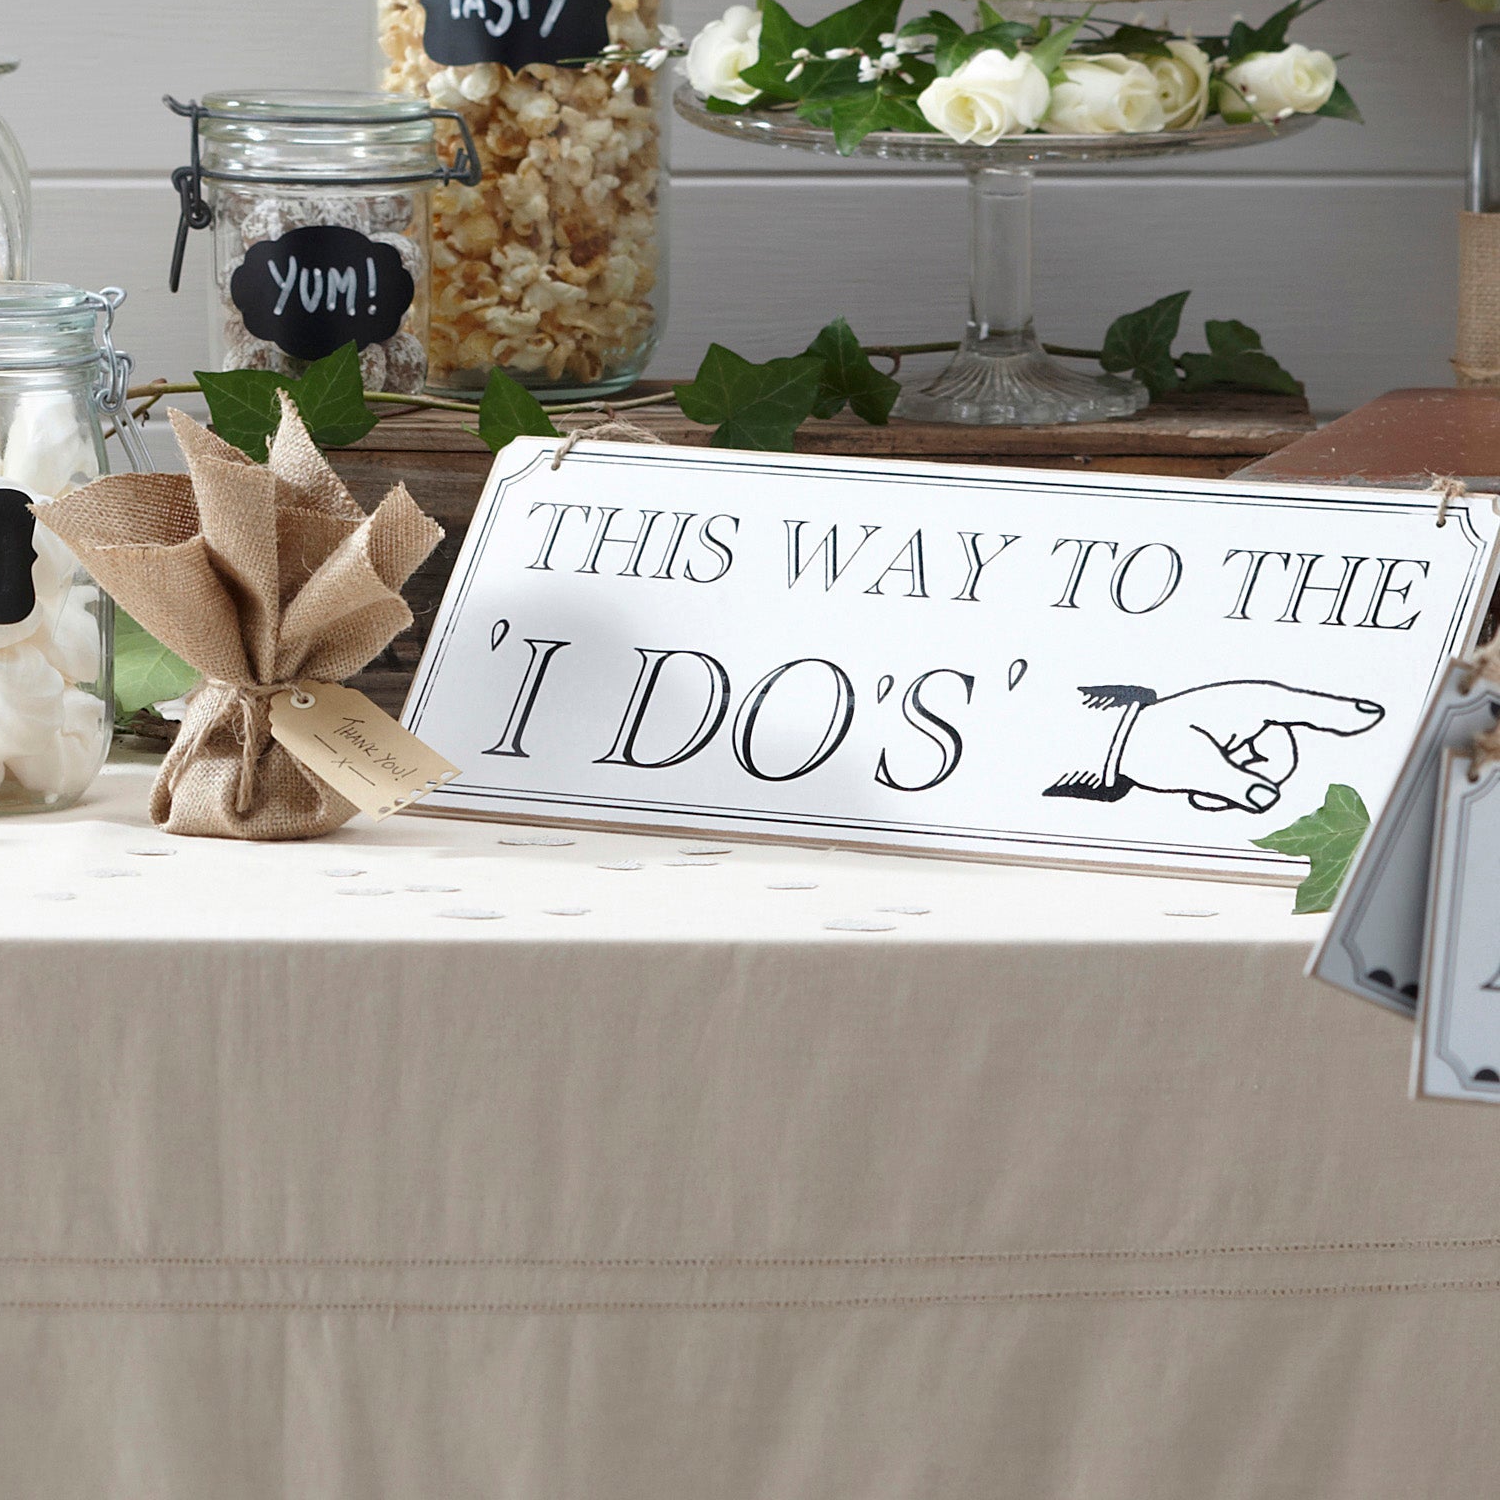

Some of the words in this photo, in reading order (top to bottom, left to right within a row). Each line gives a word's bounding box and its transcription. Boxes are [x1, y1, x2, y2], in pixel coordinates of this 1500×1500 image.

[267, 255, 377, 316] YUM!
[525, 502, 740, 583] THIS
[783, 520, 1022, 601] WAY
[1050, 538, 1184, 614] TO
[1222, 549, 1431, 630] THE
[333, 716, 380, 757] THANK
[373, 752, 418, 782] YOU!
